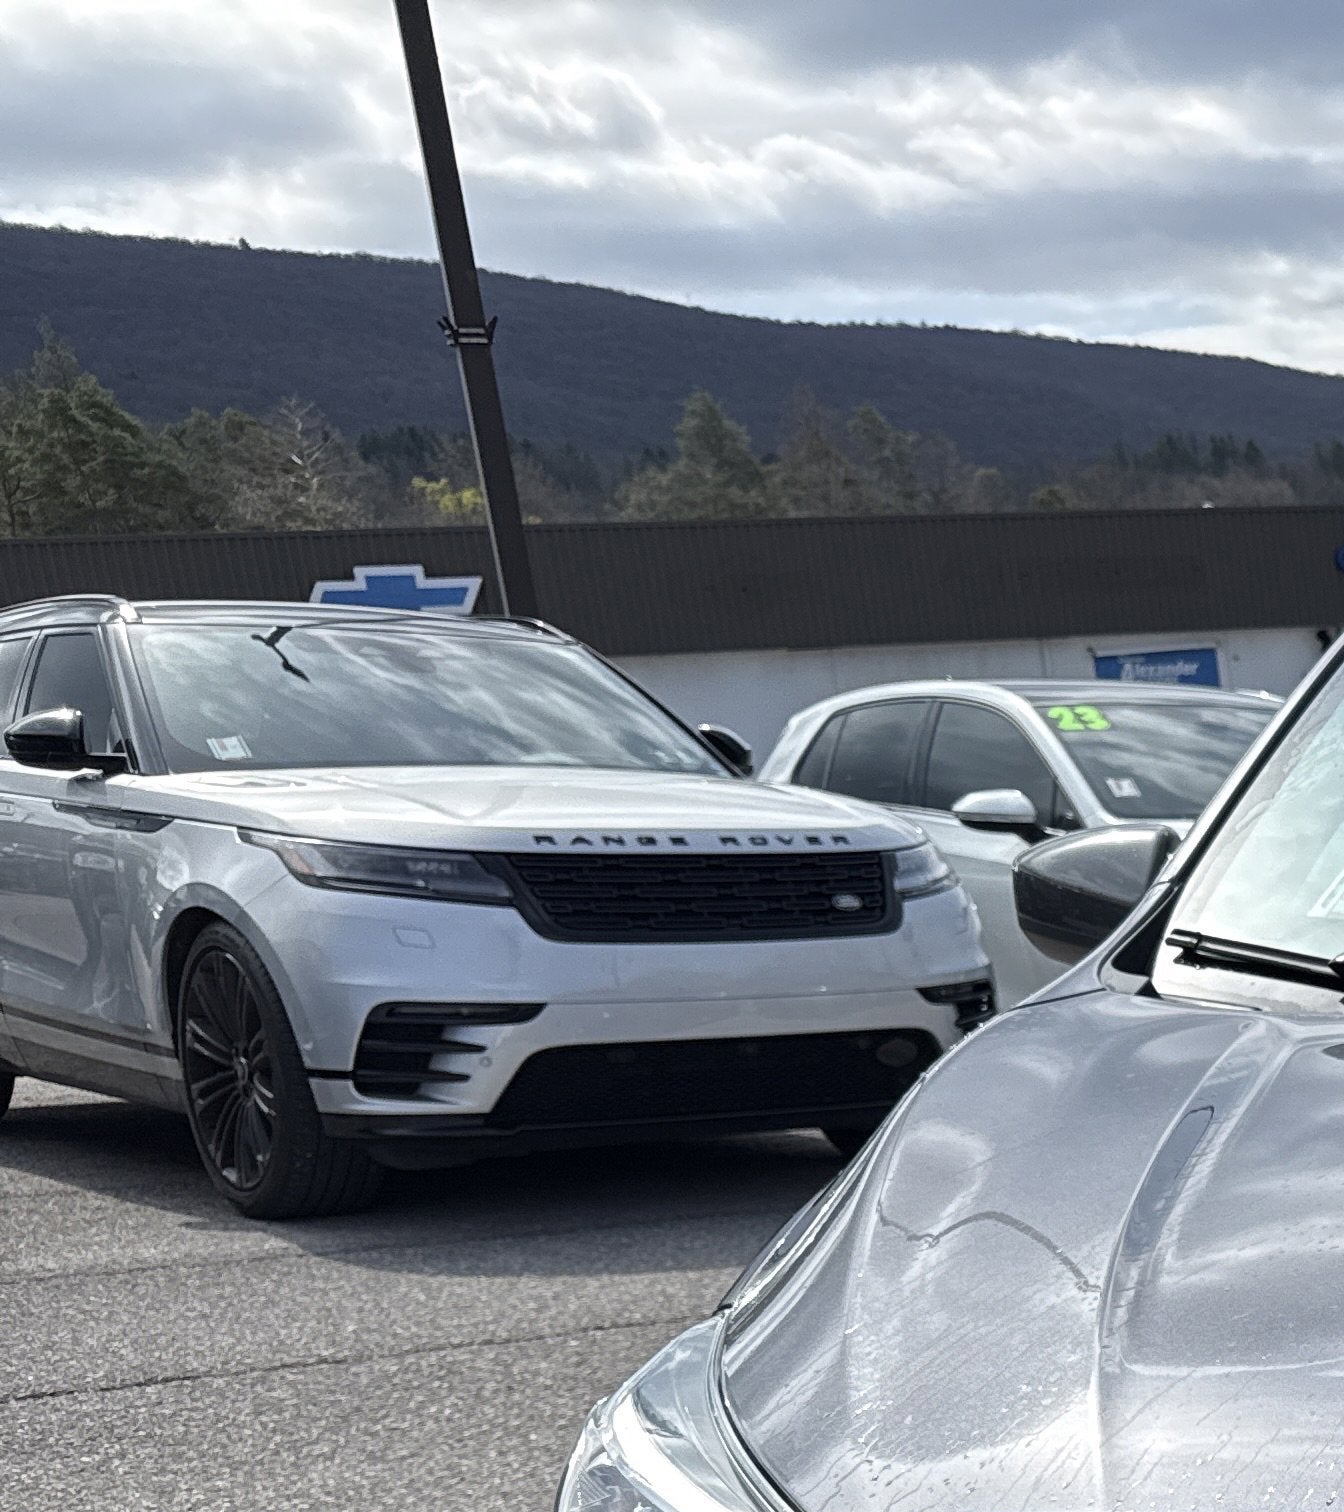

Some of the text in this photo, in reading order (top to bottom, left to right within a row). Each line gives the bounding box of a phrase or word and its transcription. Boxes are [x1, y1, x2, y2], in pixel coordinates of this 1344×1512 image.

[1048, 705, 1112, 731] 23
[532, 834, 851, 847] RANGE ROVER
